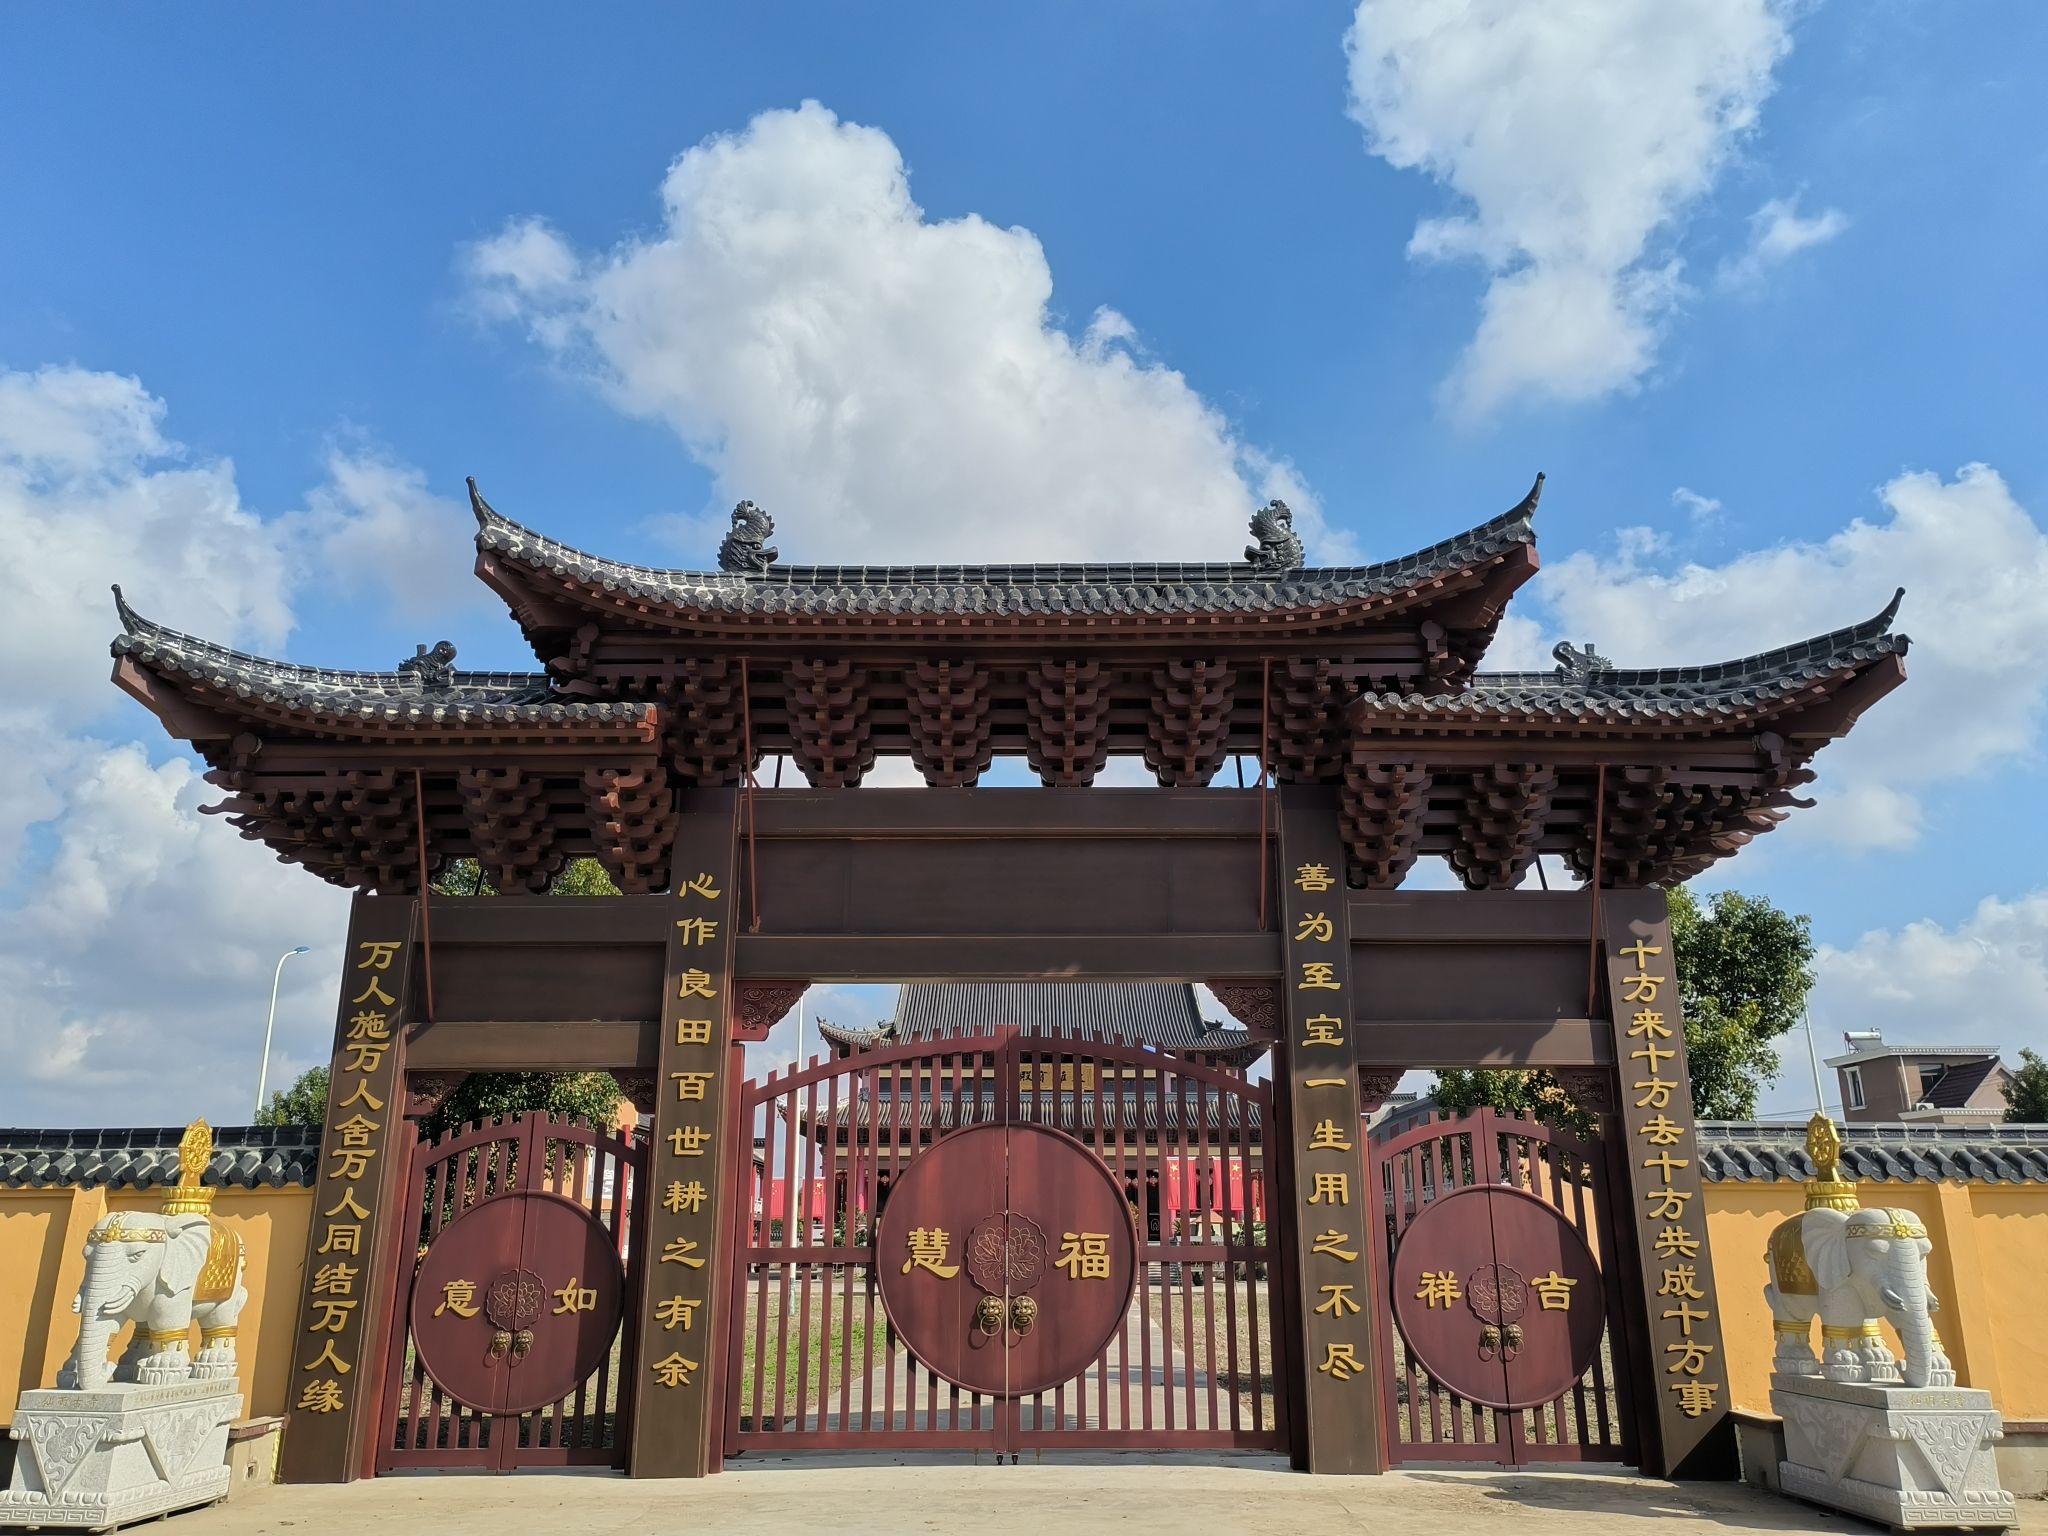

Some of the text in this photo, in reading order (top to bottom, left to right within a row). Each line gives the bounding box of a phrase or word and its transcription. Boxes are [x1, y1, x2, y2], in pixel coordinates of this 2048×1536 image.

[297, 940, 401, 1412] 万人施万人舍万人同结万人缘
[652, 872, 721, 1387] 心作良田百世耕之有余
[1294, 863, 1364, 1380] 善为至宝一生用之不尽
[1619, 939, 1719, 1417] 十方来十方去十方共成十方事
